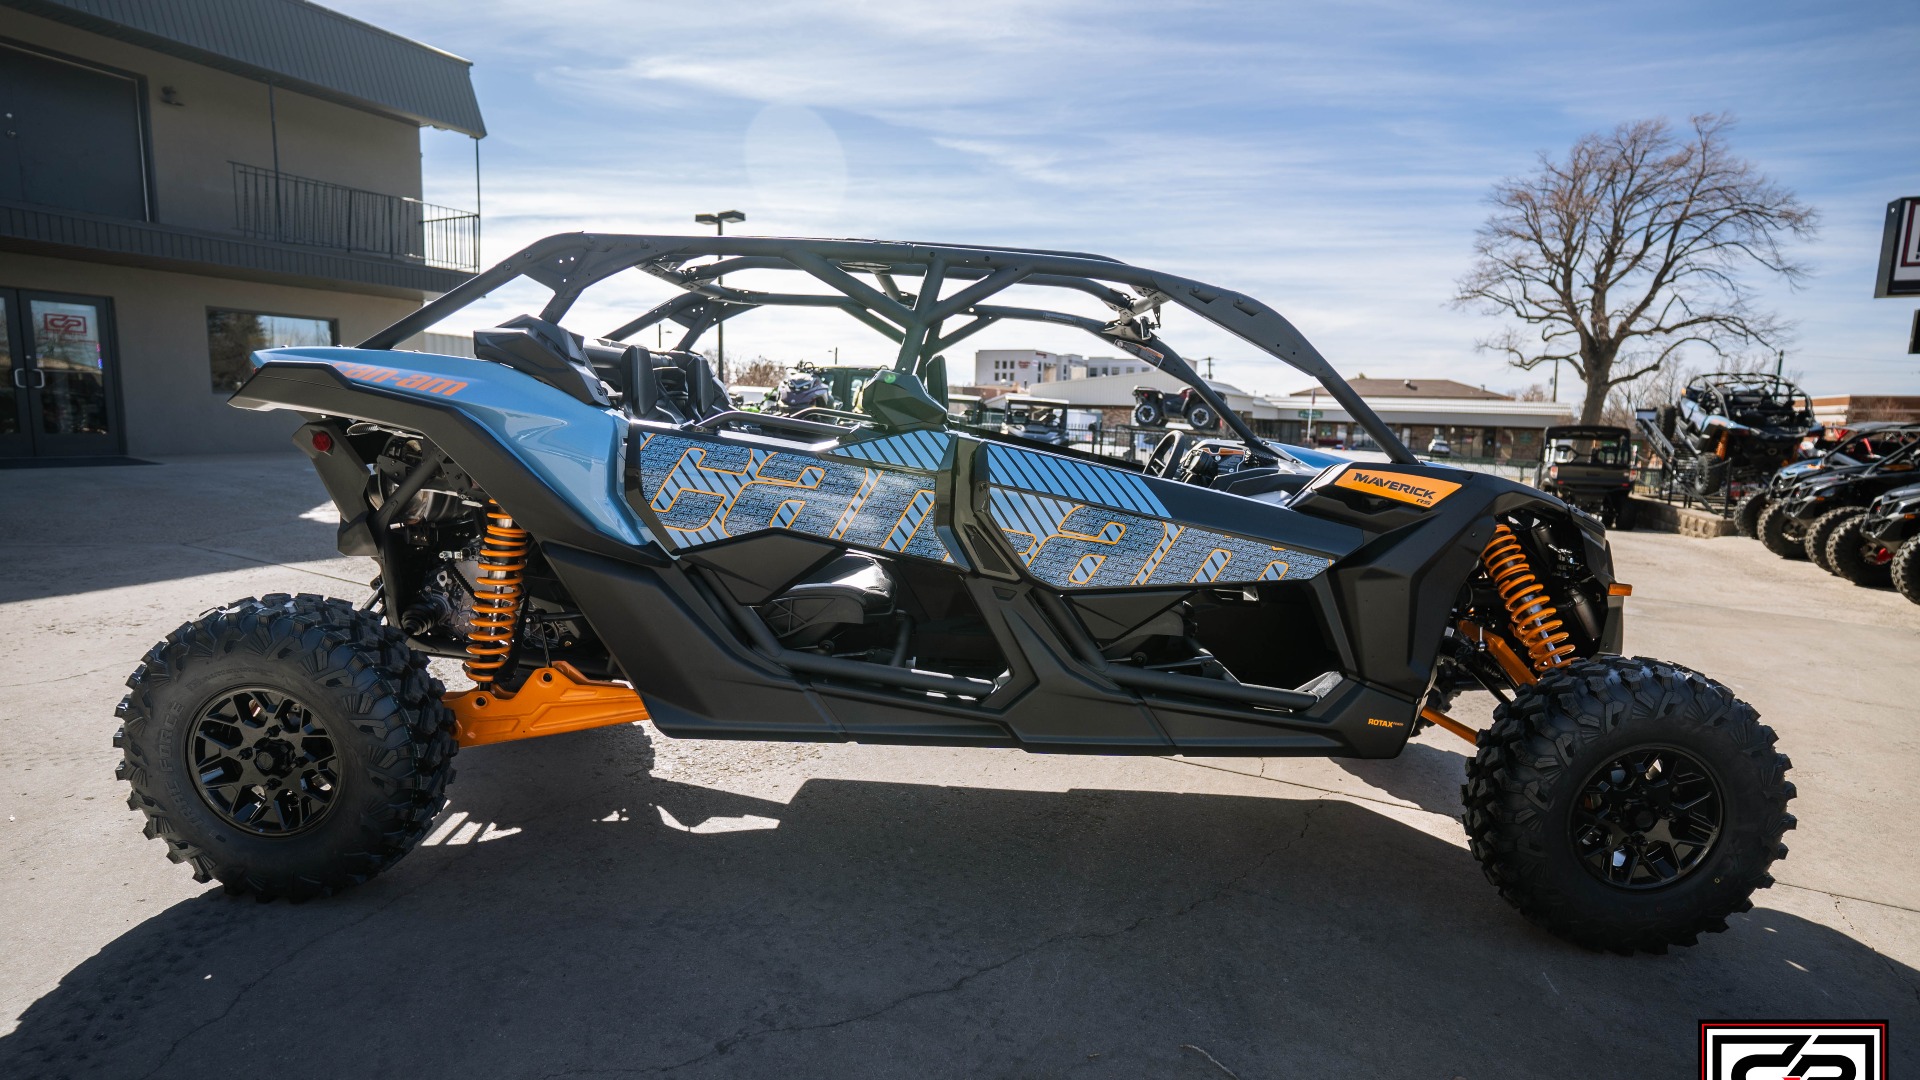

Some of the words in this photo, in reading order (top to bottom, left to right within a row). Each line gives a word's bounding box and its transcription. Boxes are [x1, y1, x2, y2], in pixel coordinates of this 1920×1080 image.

[1353, 472, 1437, 499] MAVERICK
[1416, 498, 1432, 506] RS
[1368, 718, 1394, 728] ROTAX
[159, 701, 185, 772] FORCE
